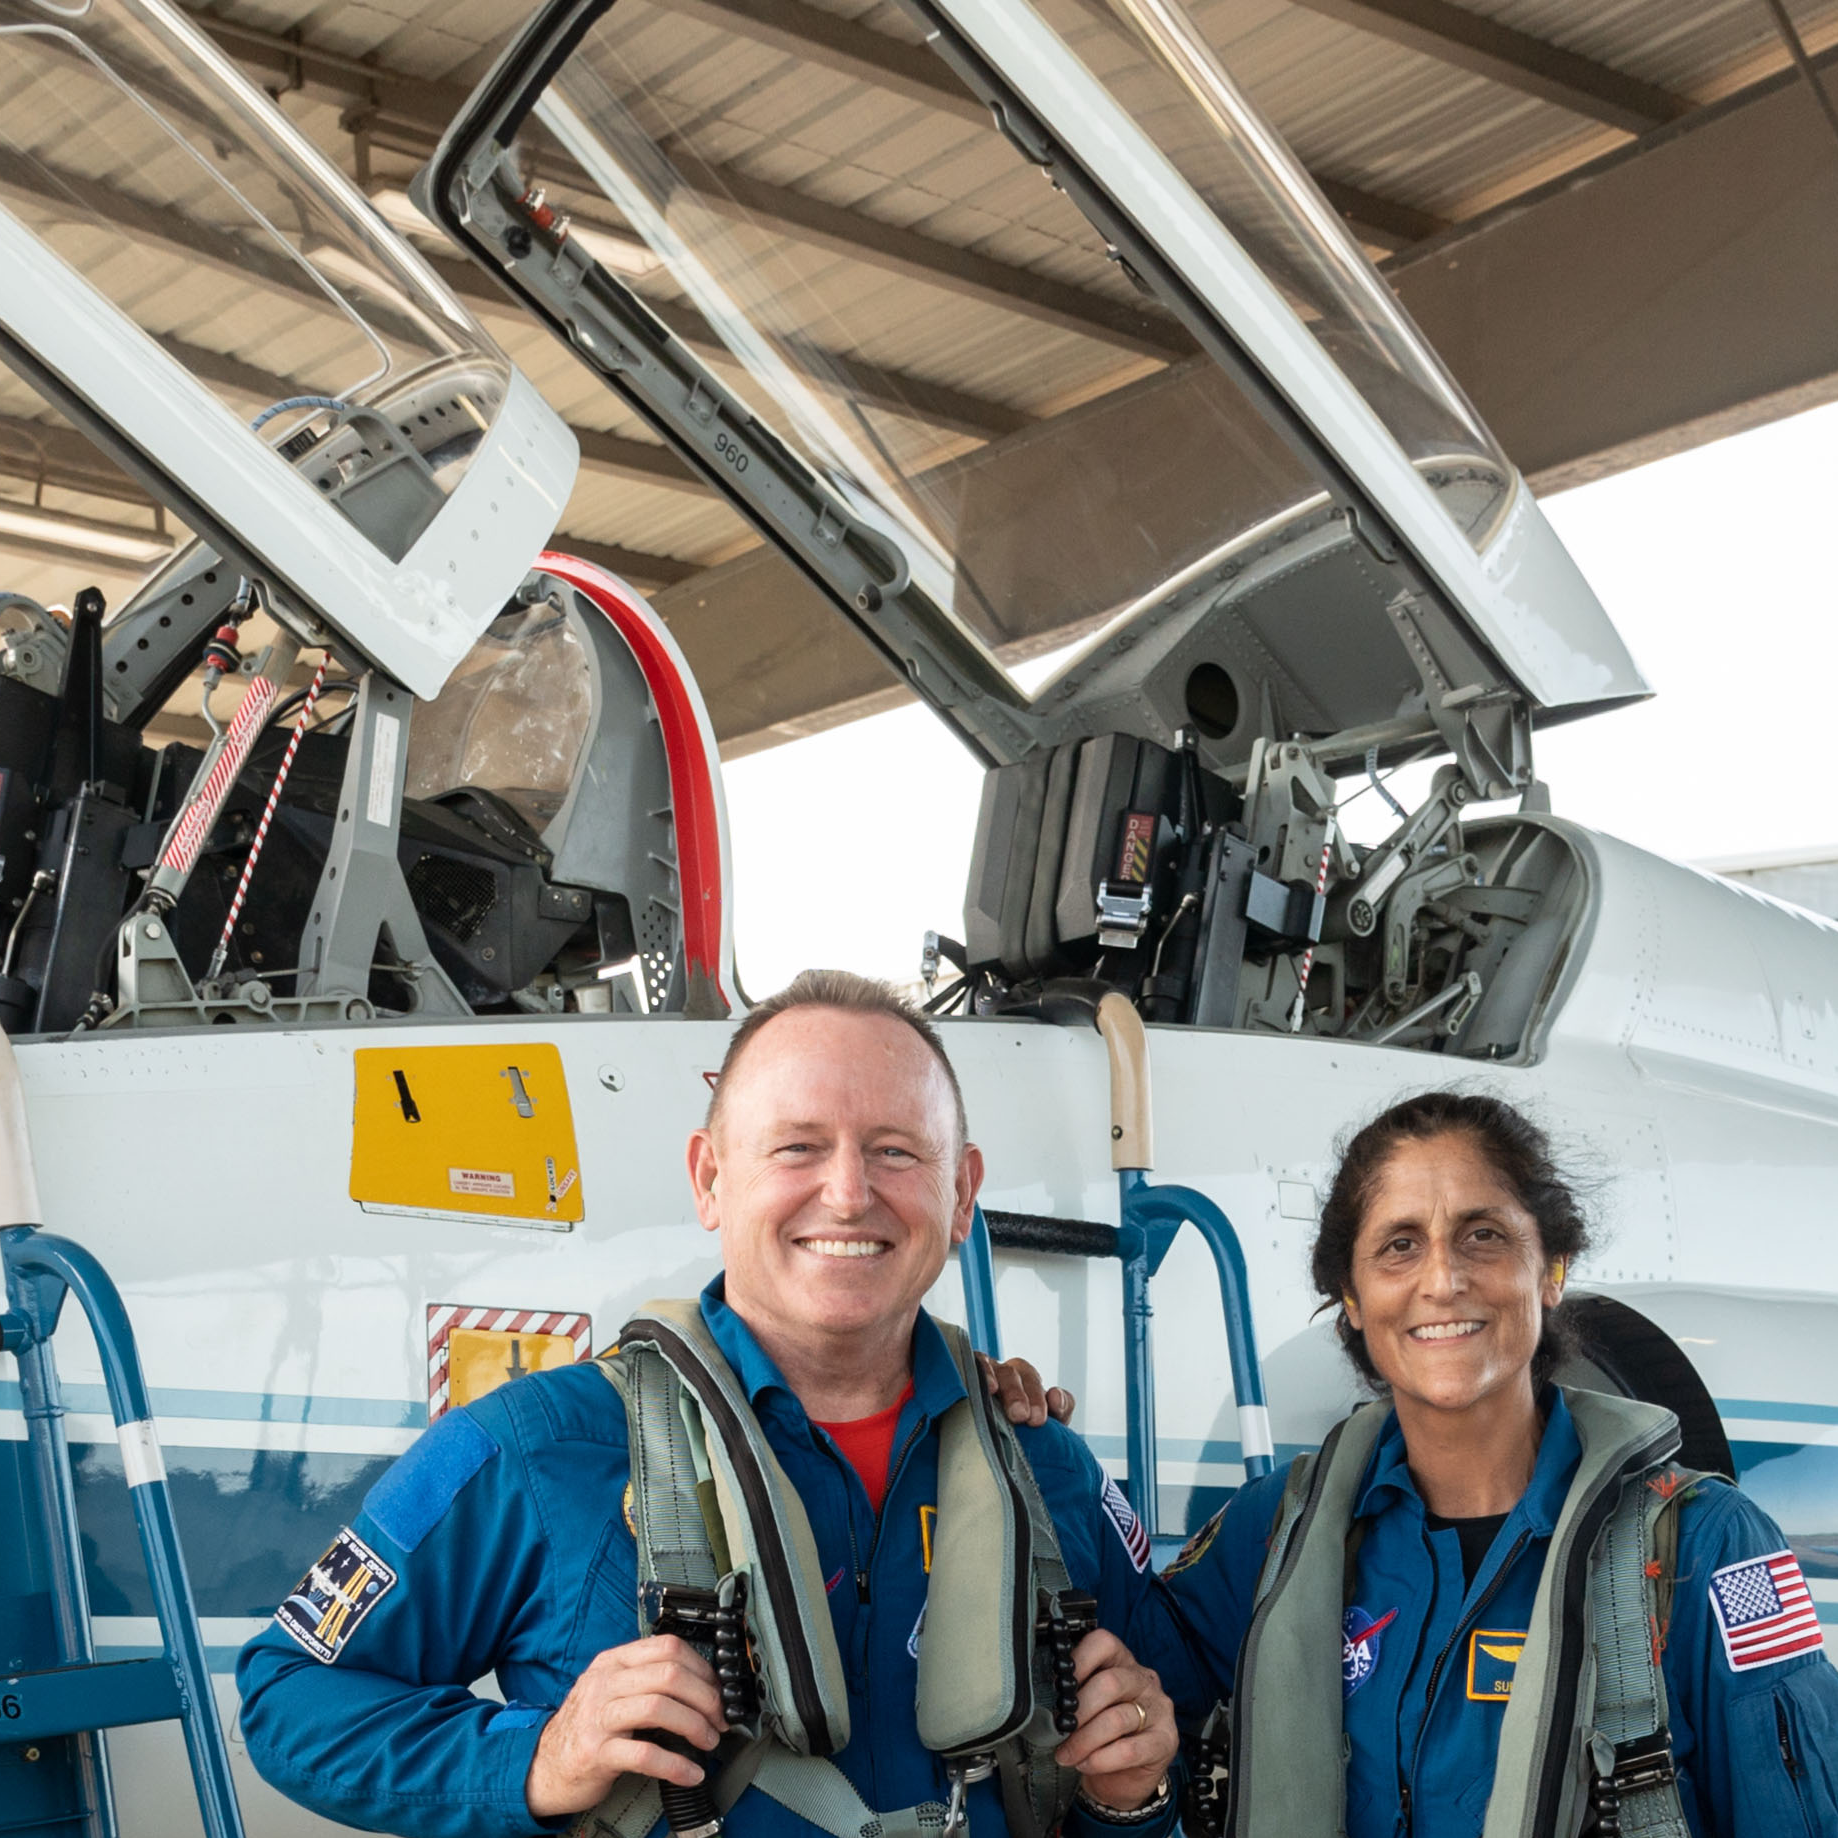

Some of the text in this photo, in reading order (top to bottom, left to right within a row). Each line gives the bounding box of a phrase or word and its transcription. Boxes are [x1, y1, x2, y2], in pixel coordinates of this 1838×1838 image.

[714, 433, 749, 473] 960
[461, 1172, 501, 1182] WARNING
[1342, 1639, 1372, 1663] SA
